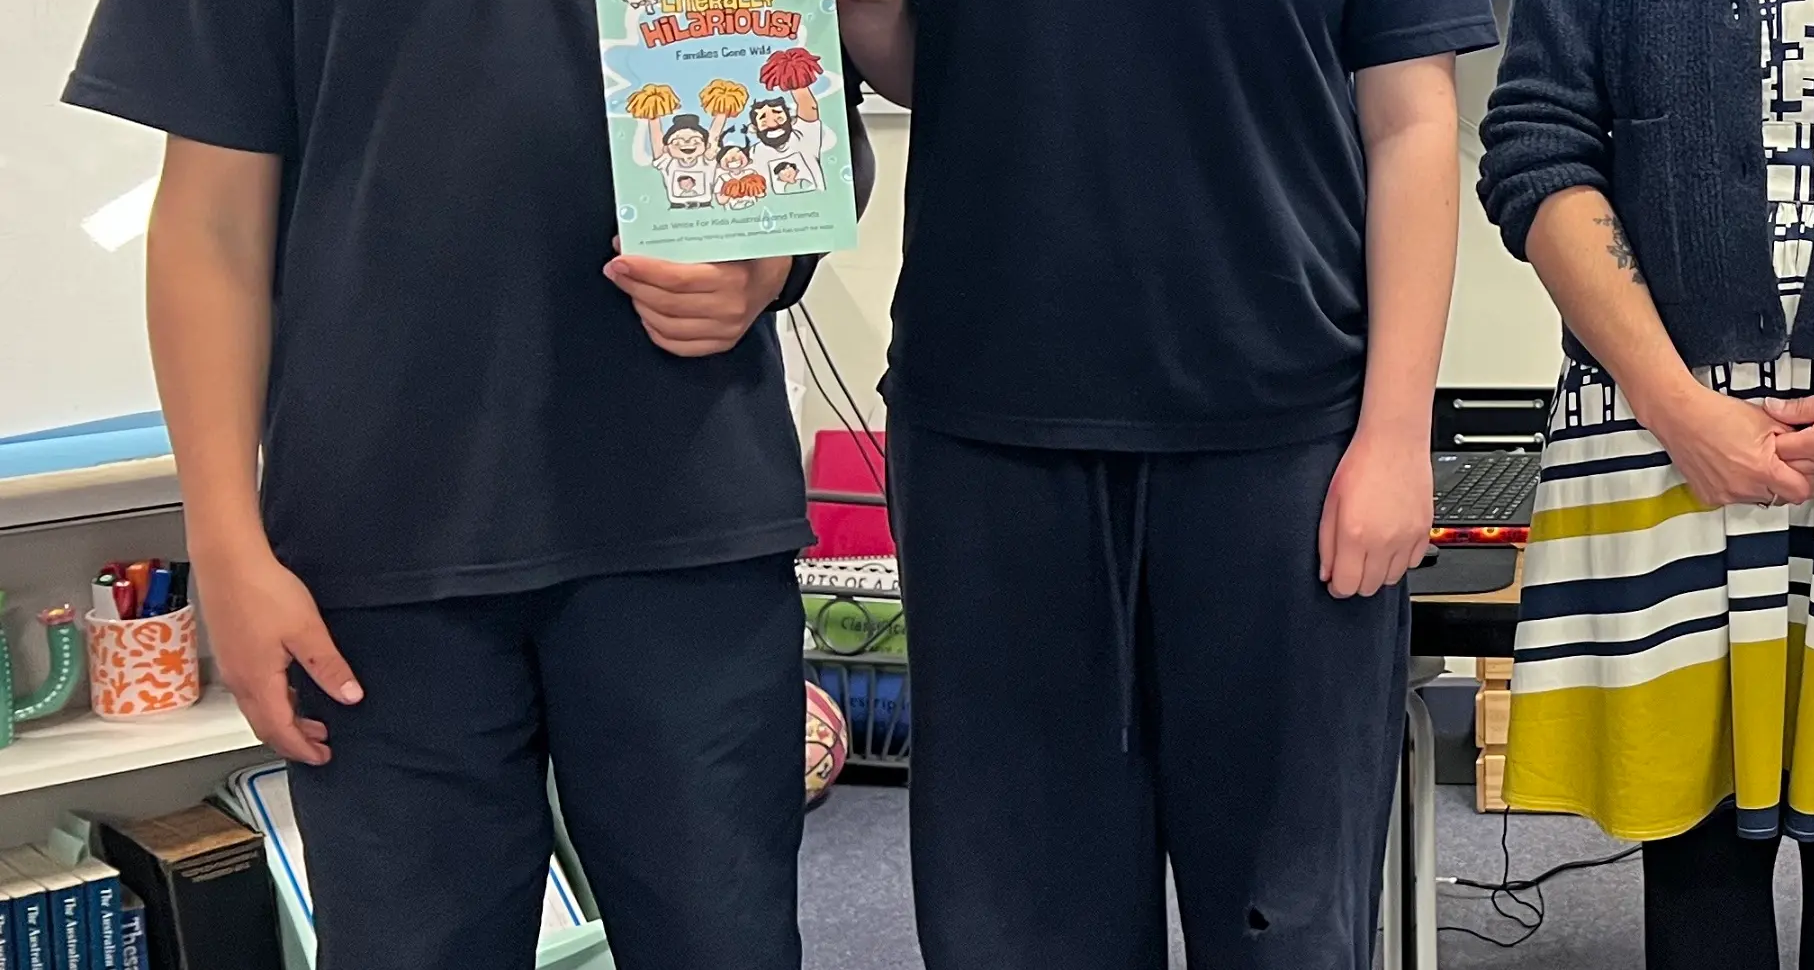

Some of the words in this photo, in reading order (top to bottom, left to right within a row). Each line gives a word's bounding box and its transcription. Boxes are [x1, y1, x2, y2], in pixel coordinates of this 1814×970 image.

[676, 49, 719, 61] Families
[721, 46, 746, 58] Gone
[749, 45, 772, 57] Wild
